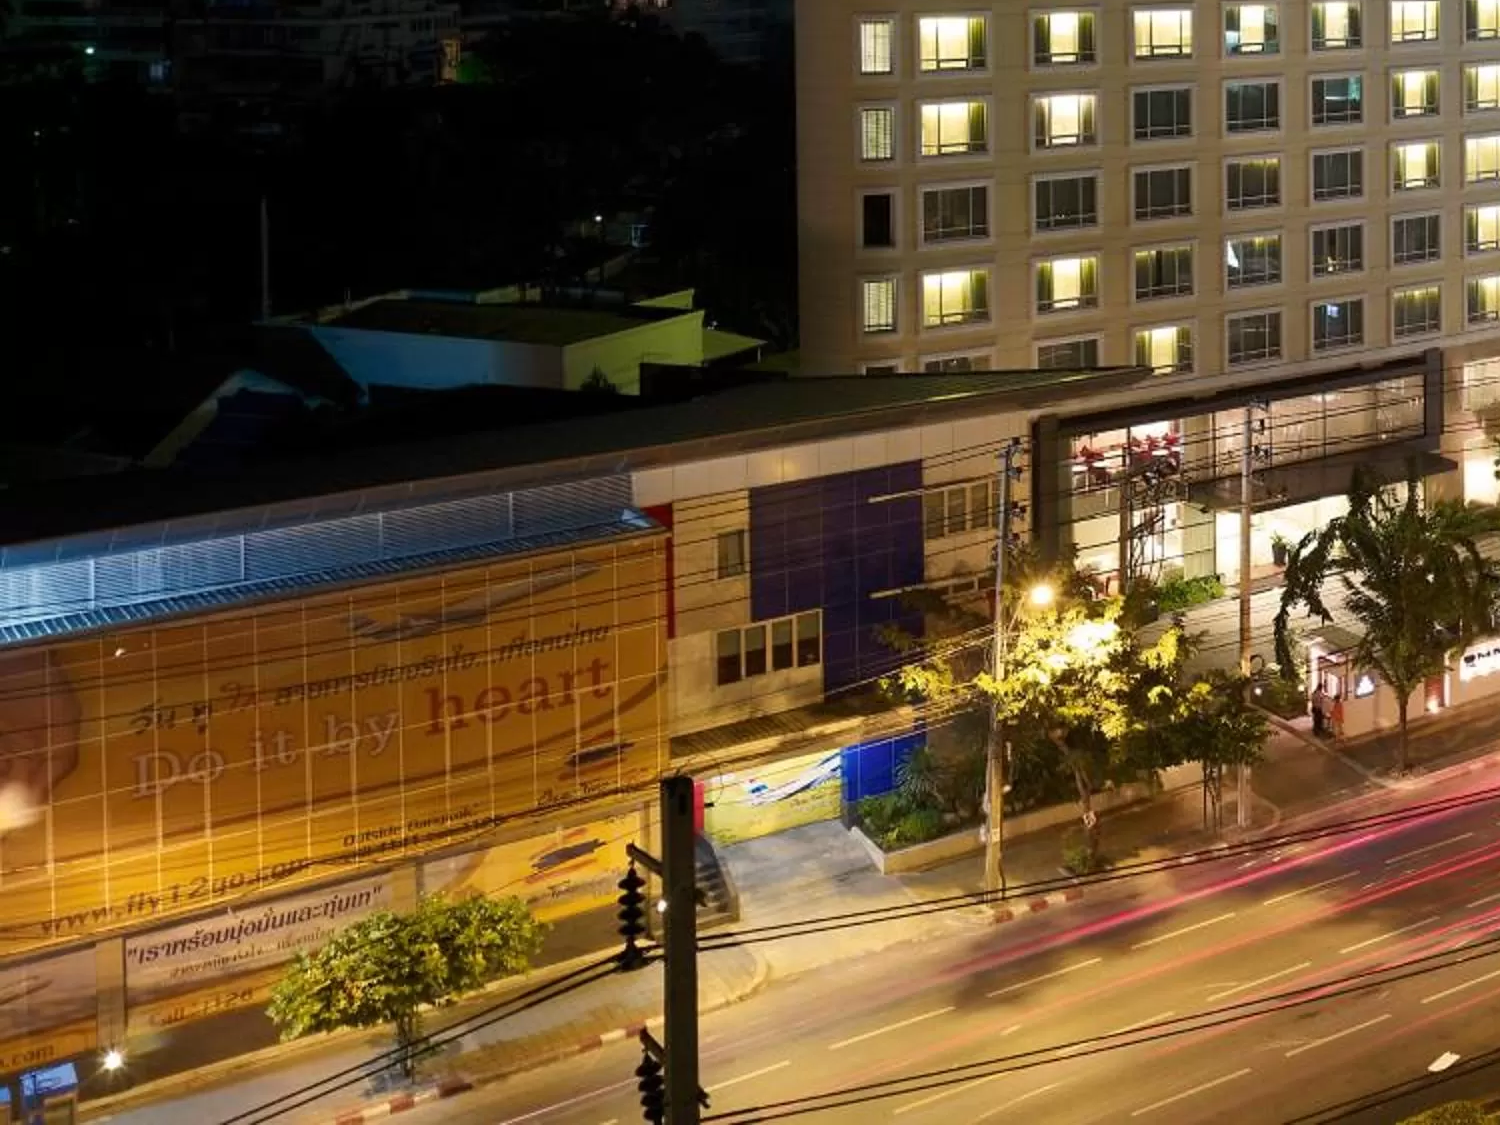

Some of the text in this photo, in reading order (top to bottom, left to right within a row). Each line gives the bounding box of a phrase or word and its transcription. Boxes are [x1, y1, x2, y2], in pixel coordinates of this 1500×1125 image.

[132, 657, 614, 799] Do it by heart
